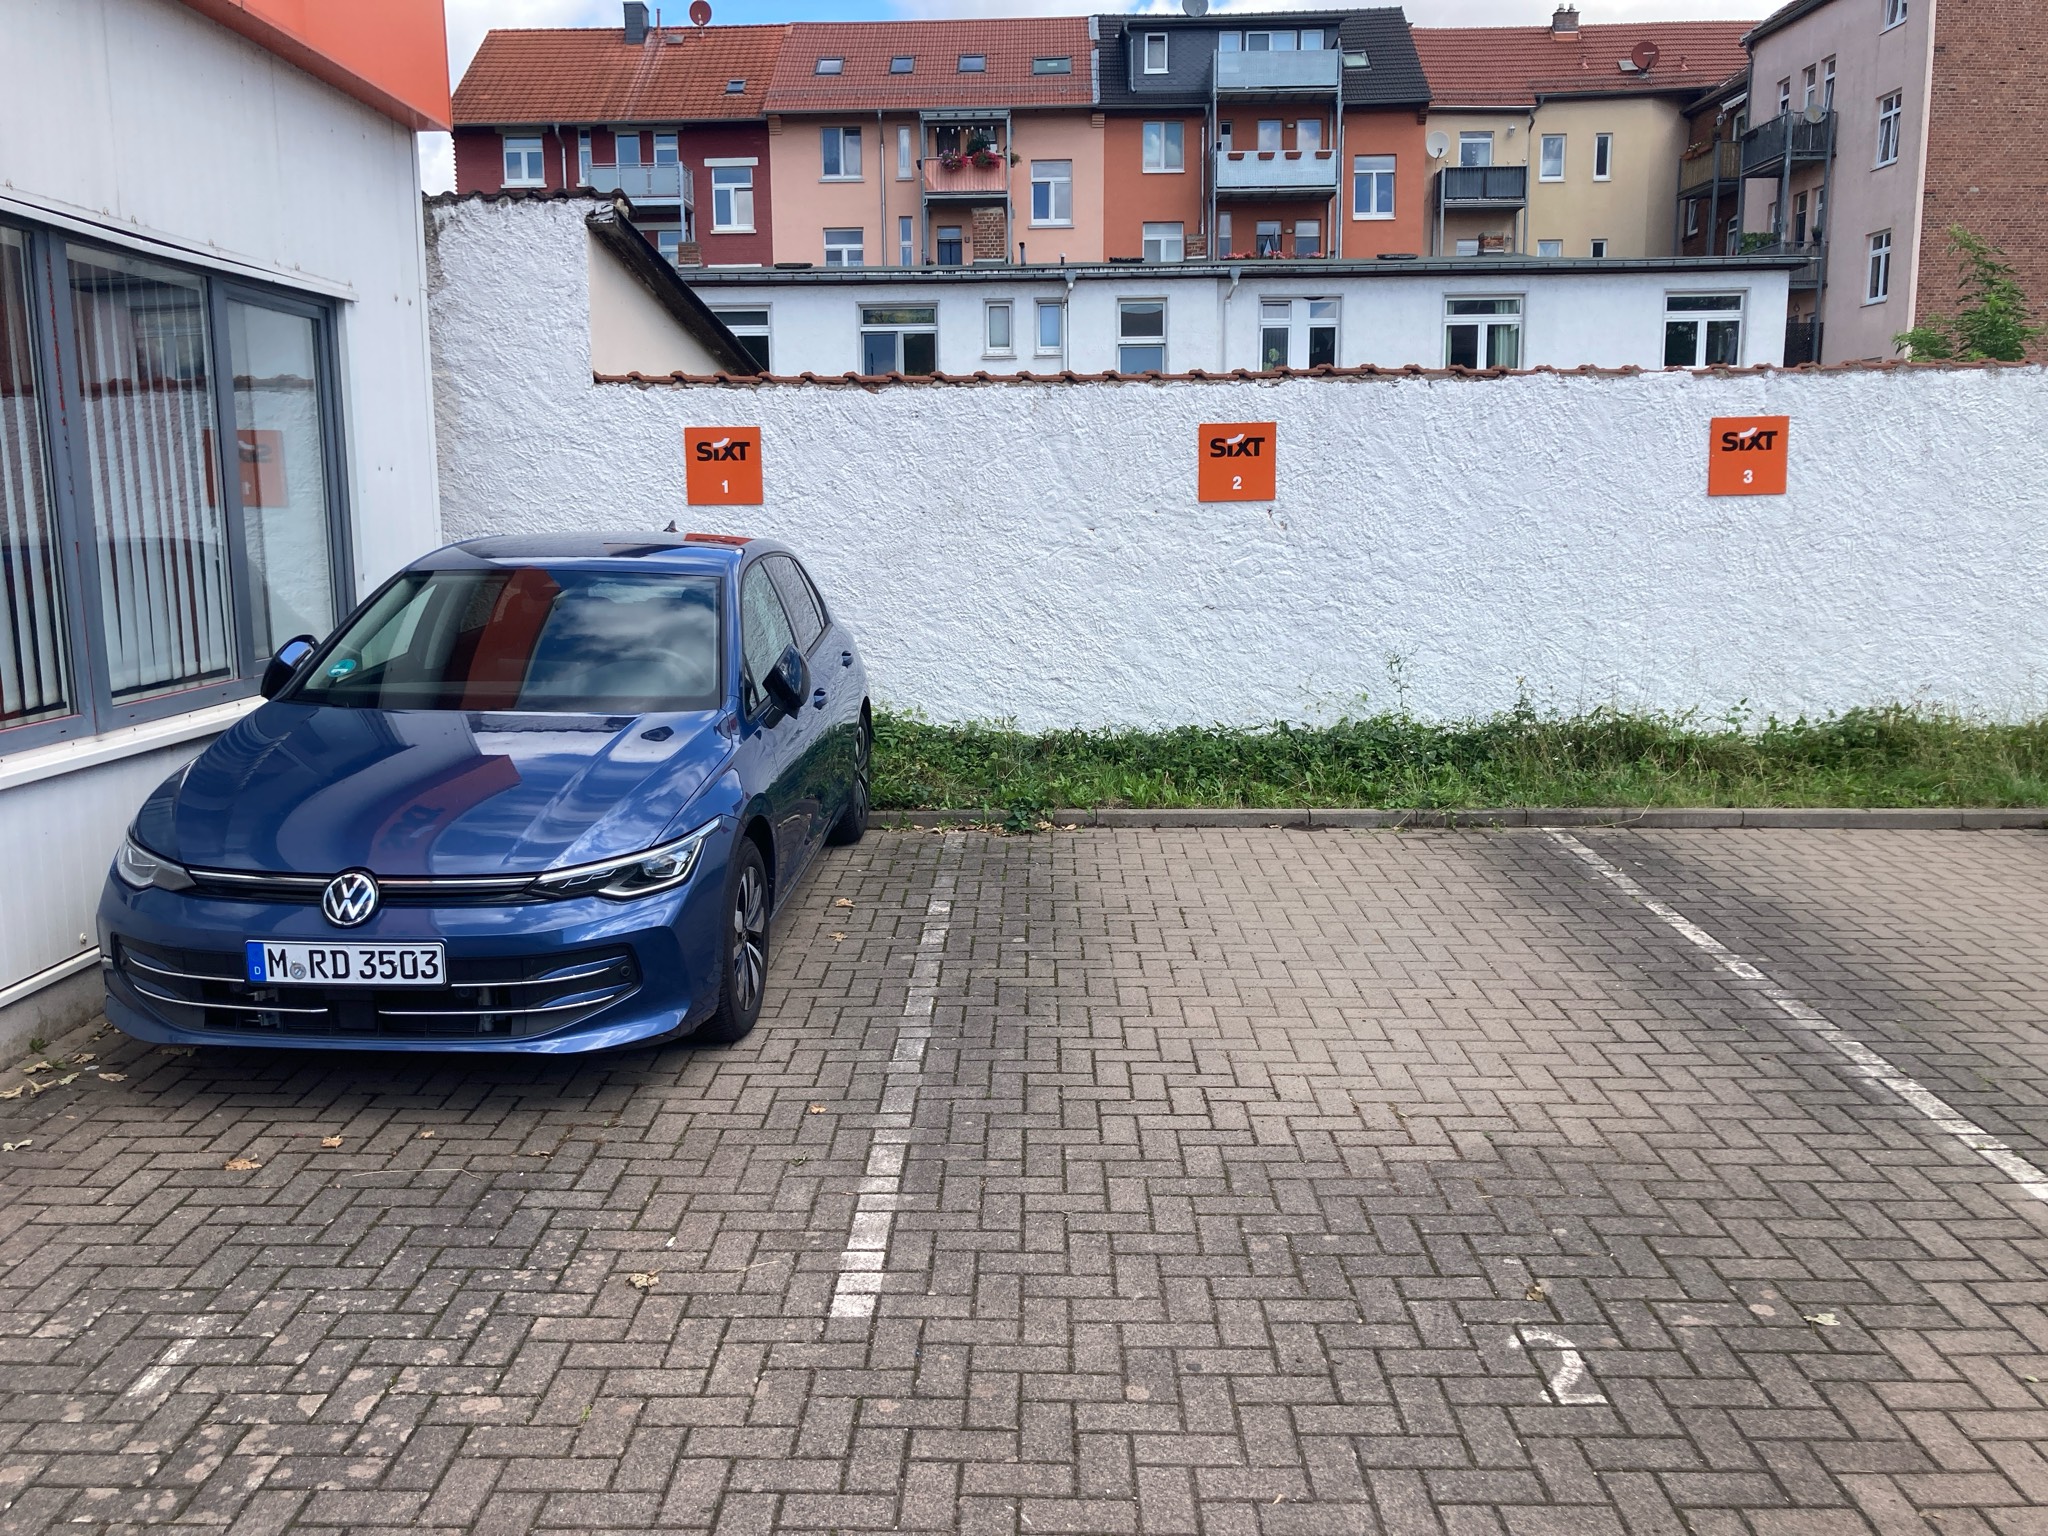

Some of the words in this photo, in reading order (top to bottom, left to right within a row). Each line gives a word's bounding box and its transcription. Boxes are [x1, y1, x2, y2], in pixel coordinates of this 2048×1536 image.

[1232, 475, 1242, 490] 2
[1743, 469, 1753, 484] 3
[721, 479, 729, 494] 1
[253, 966, 261, 975] D
[266, 948, 288, 978] M
[308, 949, 350, 979] RD
[359, 950, 439, 980] 3503
[1507, 1327, 1609, 1405] 2
